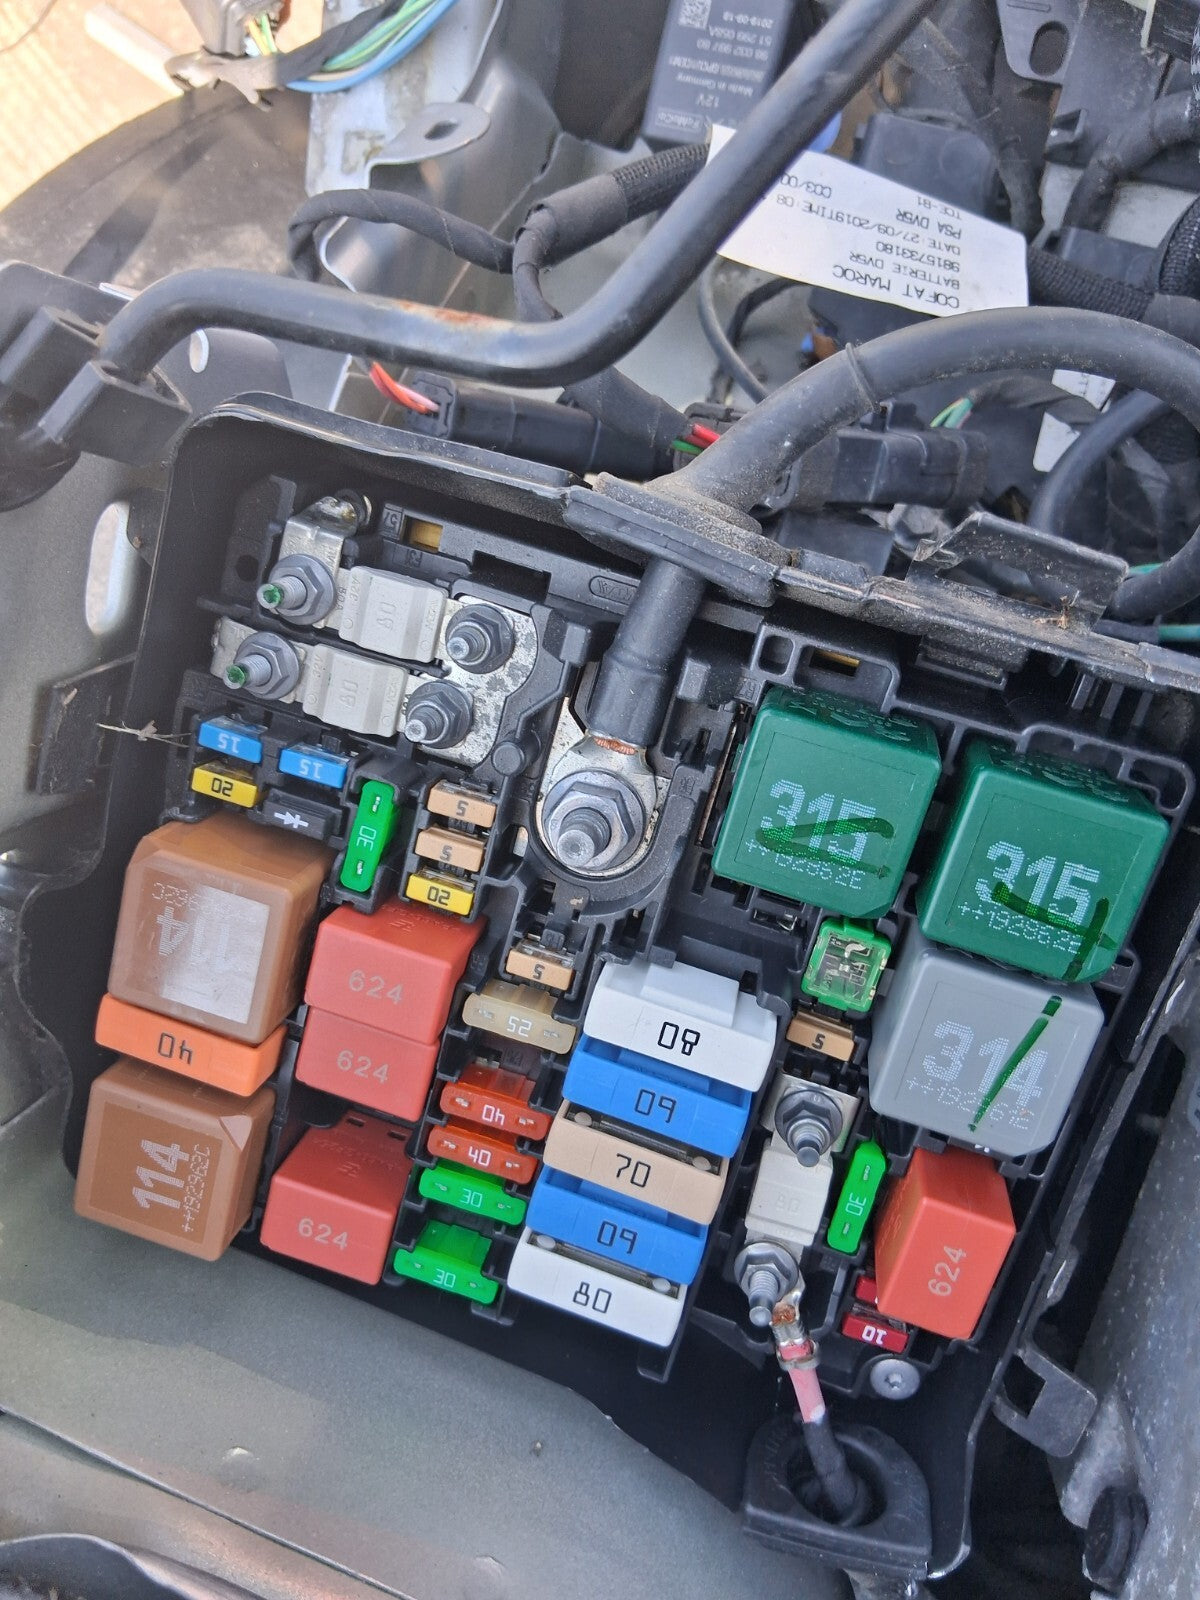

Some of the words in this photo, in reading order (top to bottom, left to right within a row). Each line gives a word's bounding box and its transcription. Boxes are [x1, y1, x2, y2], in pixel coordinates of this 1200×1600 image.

[937, 221, 962, 240] PSA
[832, 264, 892, 292] MAROC
[892, 263, 961, 291] BATTERIE
[901, 283, 961, 309] COFAT
[217, 733, 241, 754] 15
[299, 758, 325, 781] 15
[211, 777, 235, 798] 20
[456, 801, 468, 817] 5
[760, 779, 877, 865] 315
[355, 825, 378, 852] 30
[439, 845, 453, 862] 5
[426, 885, 451, 907] 20
[974, 840, 1100, 931] 315
[532, 964, 544, 980] 5
[348, 969, 403, 1005] 624
[507, 1015, 533, 1038] 25
[657, 1021, 701, 1056] 80
[157, 1031, 194, 1065] 40
[812, 1033, 826, 1050] 5
[337, 1049, 390, 1084] 624
[923, 1020, 1050, 1108] 314
[481, 1104, 506, 1127] 40
[634, 1088, 678, 1124] 60
[467, 1147, 492, 1168] 40
[132, 1139, 190, 1210] 114
[615, 1153, 652, 1189] 70
[459, 1187, 484, 1209] 30
[845, 1191, 867, 1217] 30
[297, 1217, 349, 1251] 624
[596, 1220, 639, 1255] 60
[432, 1268, 457, 1290] 30
[927, 1244, 968, 1298] 624
[572, 1281, 613, 1315] 80
[861, 1325, 888, 1346] 10
